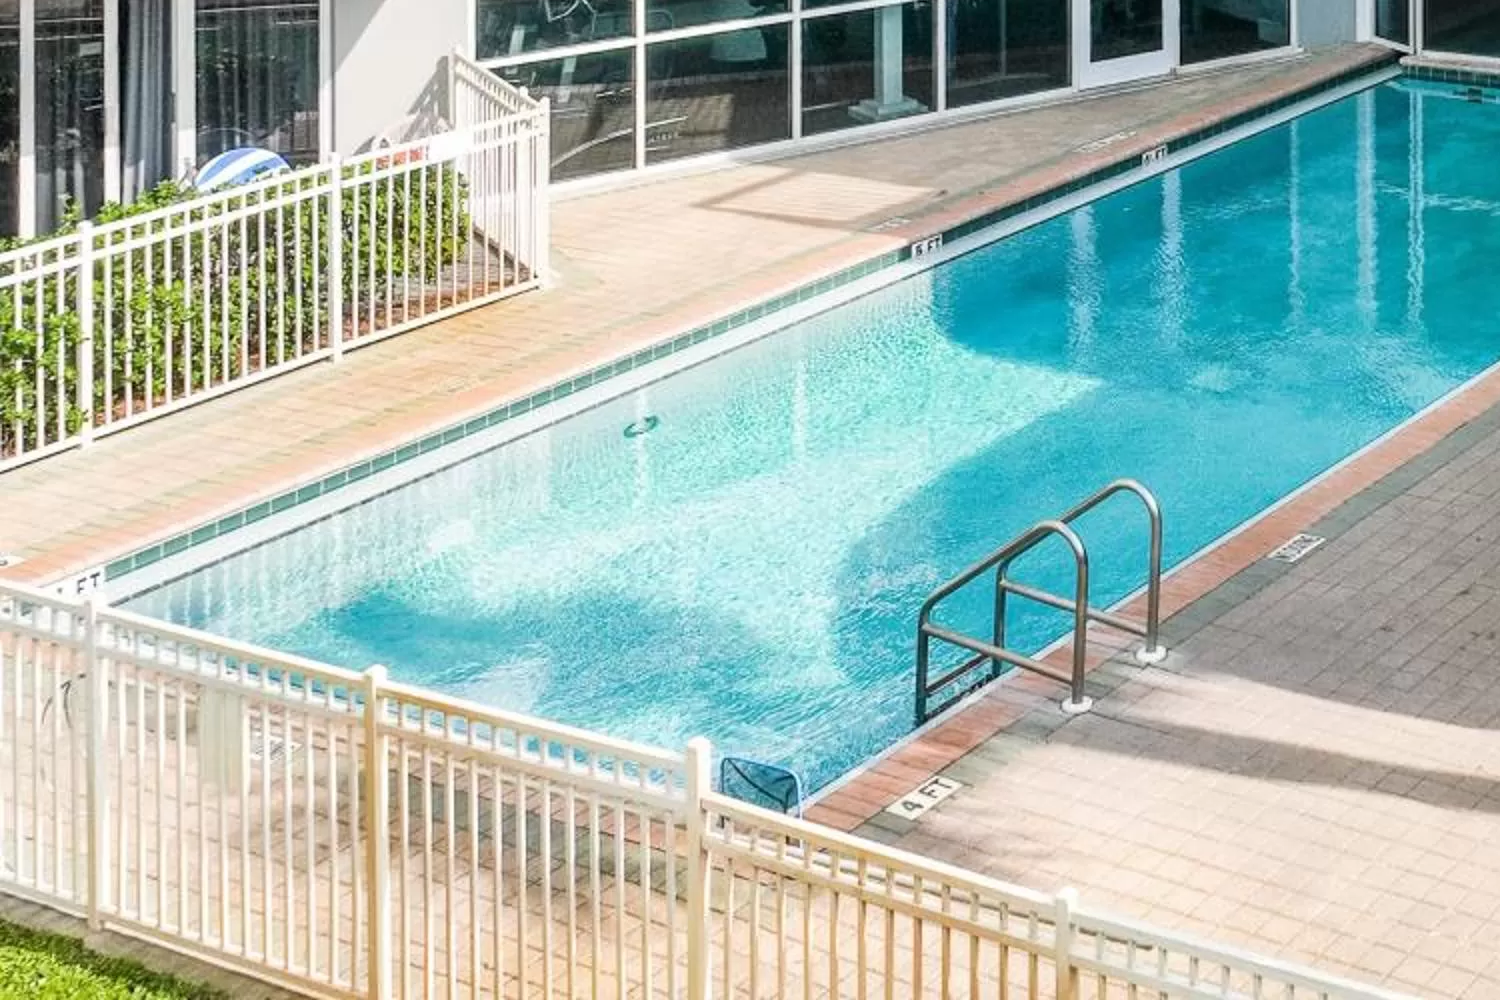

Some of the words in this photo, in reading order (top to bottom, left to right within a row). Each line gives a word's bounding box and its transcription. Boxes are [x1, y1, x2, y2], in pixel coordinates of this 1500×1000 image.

[927, 237, 940, 252] FT
[76, 571, 101, 594] FT
[902, 800, 925, 811] 4
[918, 778, 953, 799] FT
